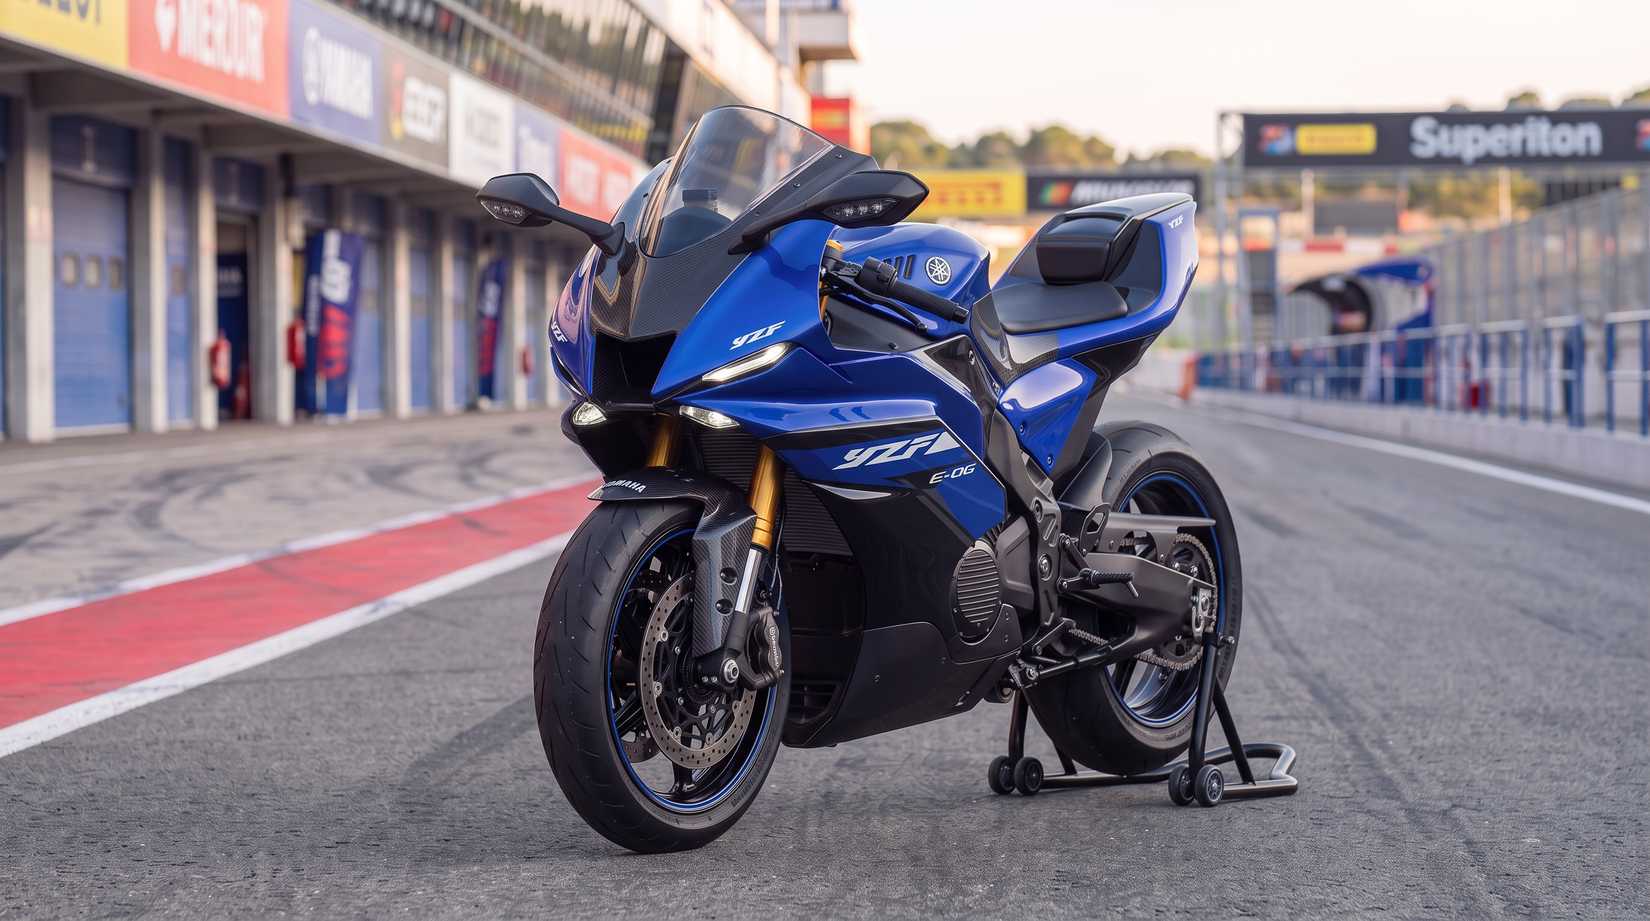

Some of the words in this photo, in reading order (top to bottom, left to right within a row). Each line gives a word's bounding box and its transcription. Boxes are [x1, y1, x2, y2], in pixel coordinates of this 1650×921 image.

[1409, 115, 1603, 165] Superiton
[550, 320, 568, 343] YZF
[729, 319, 787, 350] YZF
[831, 432, 941, 471] YZF
